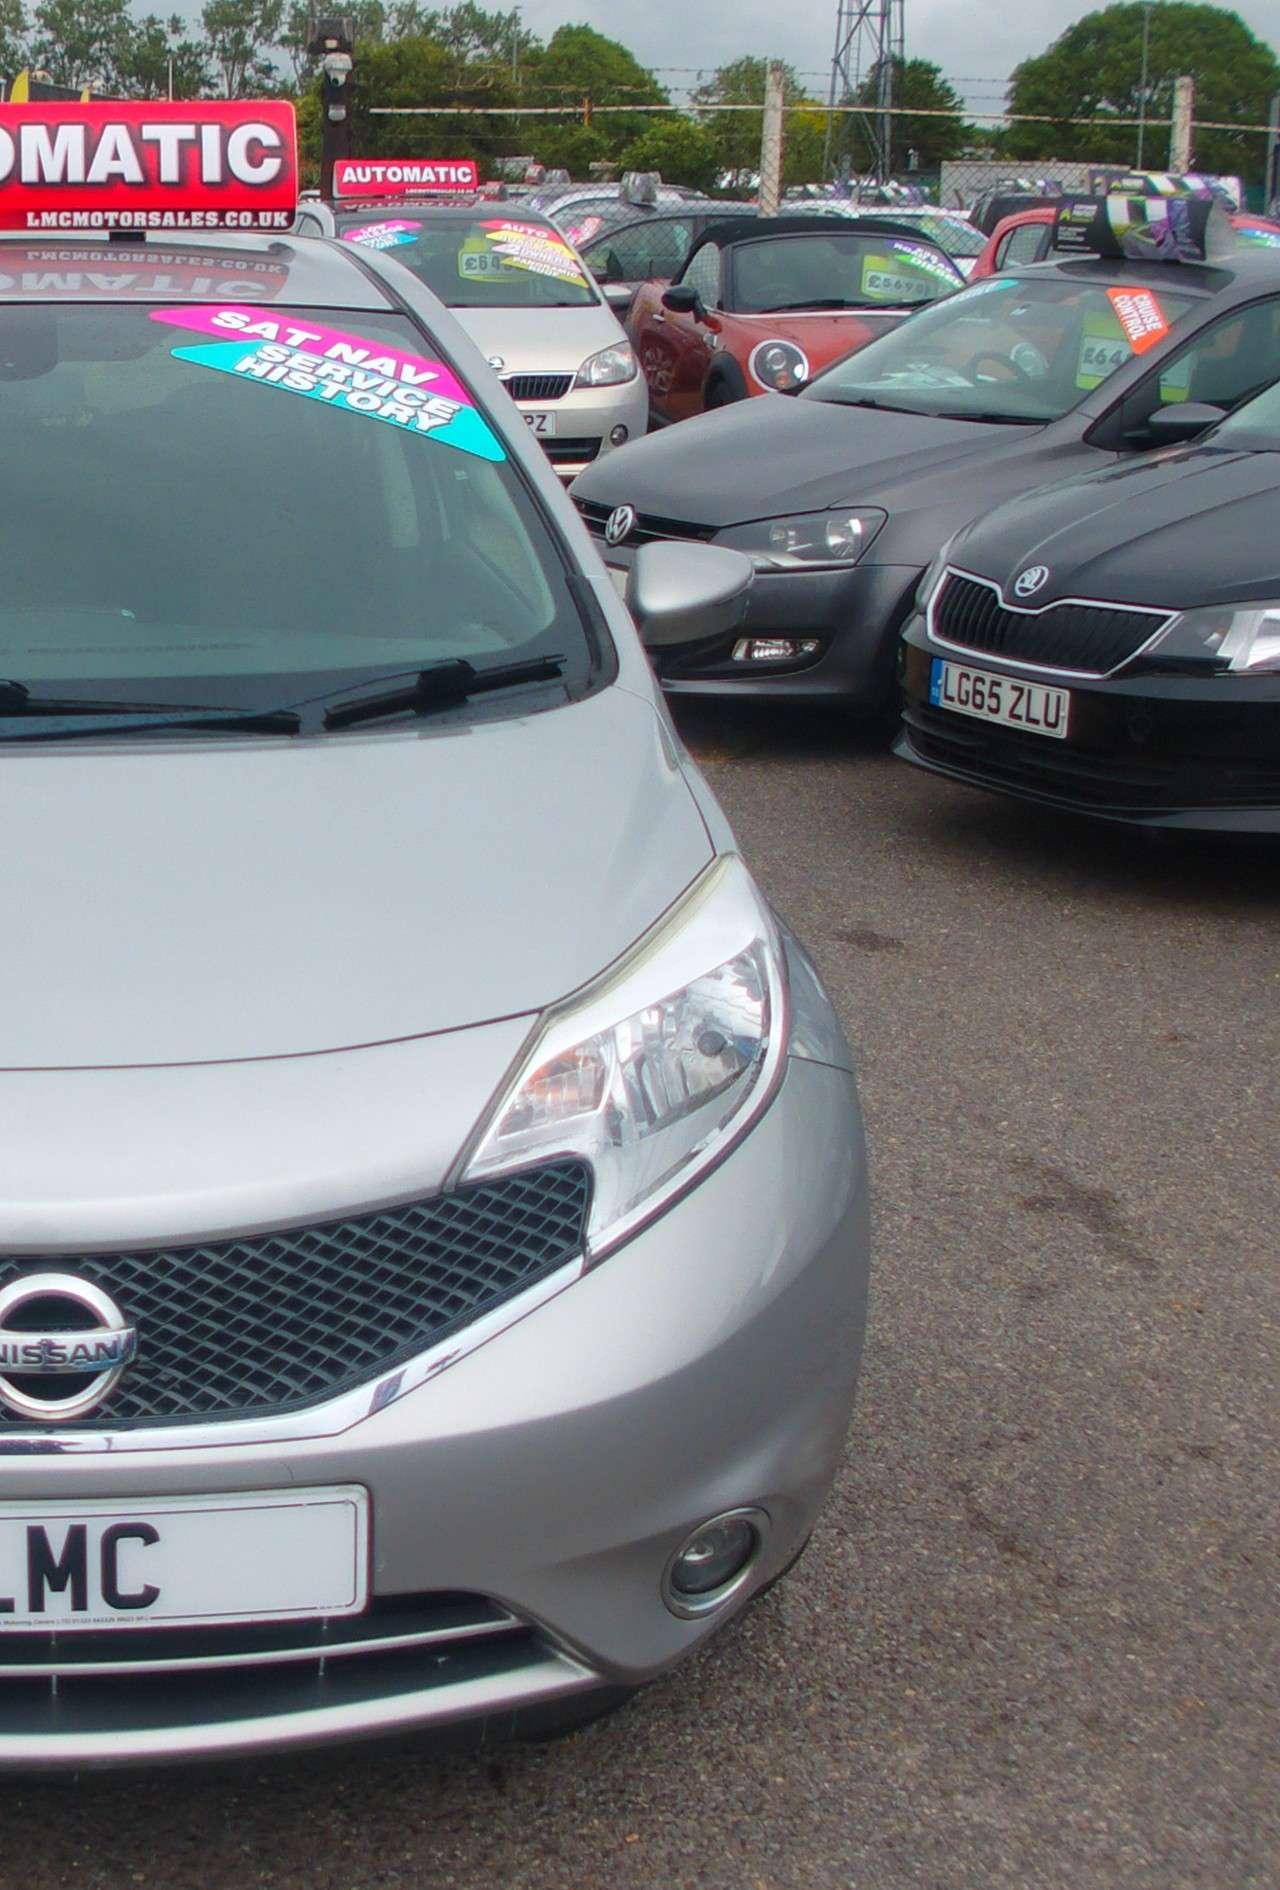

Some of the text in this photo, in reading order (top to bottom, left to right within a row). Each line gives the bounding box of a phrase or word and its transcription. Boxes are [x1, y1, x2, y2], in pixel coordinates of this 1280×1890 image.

[341, 166, 473, 184] AUTOMATIC
[26, 210, 289, 228] LMCMOTORSALES.CO.UK
[501, 223, 549, 239] AUTO
[463, 255, 506, 272] £64
[1114, 295, 1148, 341] CONTROL
[1133, 294, 1163, 332] CRUISE
[211, 311, 439, 385] SAT NAV
[233, 357, 453, 433] HISTORY
[255, 345, 462, 420] SERVICE
[943, 667, 1062, 729] LG65 ZLU
